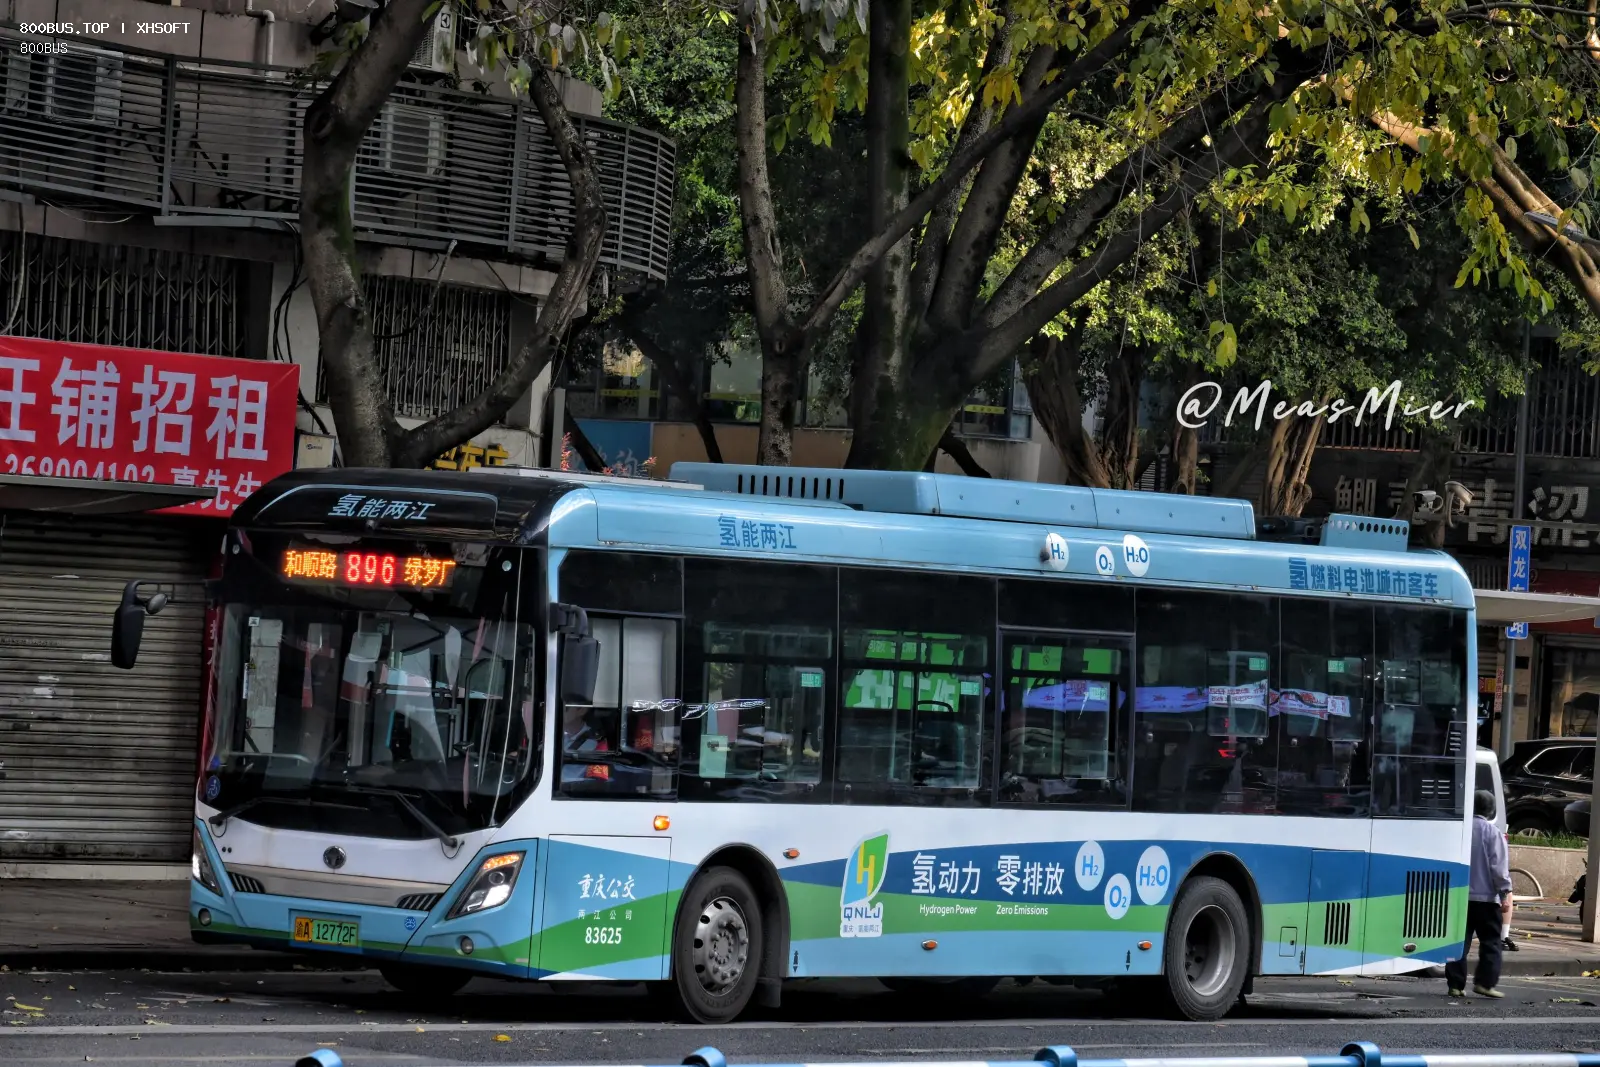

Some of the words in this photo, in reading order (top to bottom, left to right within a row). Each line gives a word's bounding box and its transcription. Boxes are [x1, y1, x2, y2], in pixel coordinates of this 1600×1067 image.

[328, 493, 436, 520] 氢能两江
[718, 513, 797, 549] 氢能两江
[284, 550, 338, 579] 和顺路
[346, 553, 397, 584] 896
[1288, 556, 1438, 597] 氢燃料电池城市客车
[578, 873, 636, 900] 重庆公交
[911, 852, 981, 895] 氢动力
[996, 855, 1065, 896] 零排放
[843, 906, 881, 921] QNLJ
[920, 904, 954, 916] Hydrogen
[955, 904, 978, 915] Power
[996, 904, 1013, 915] Zero
[1014, 904, 1049, 916] Emissions
[585, 926, 622, 944] 83625
